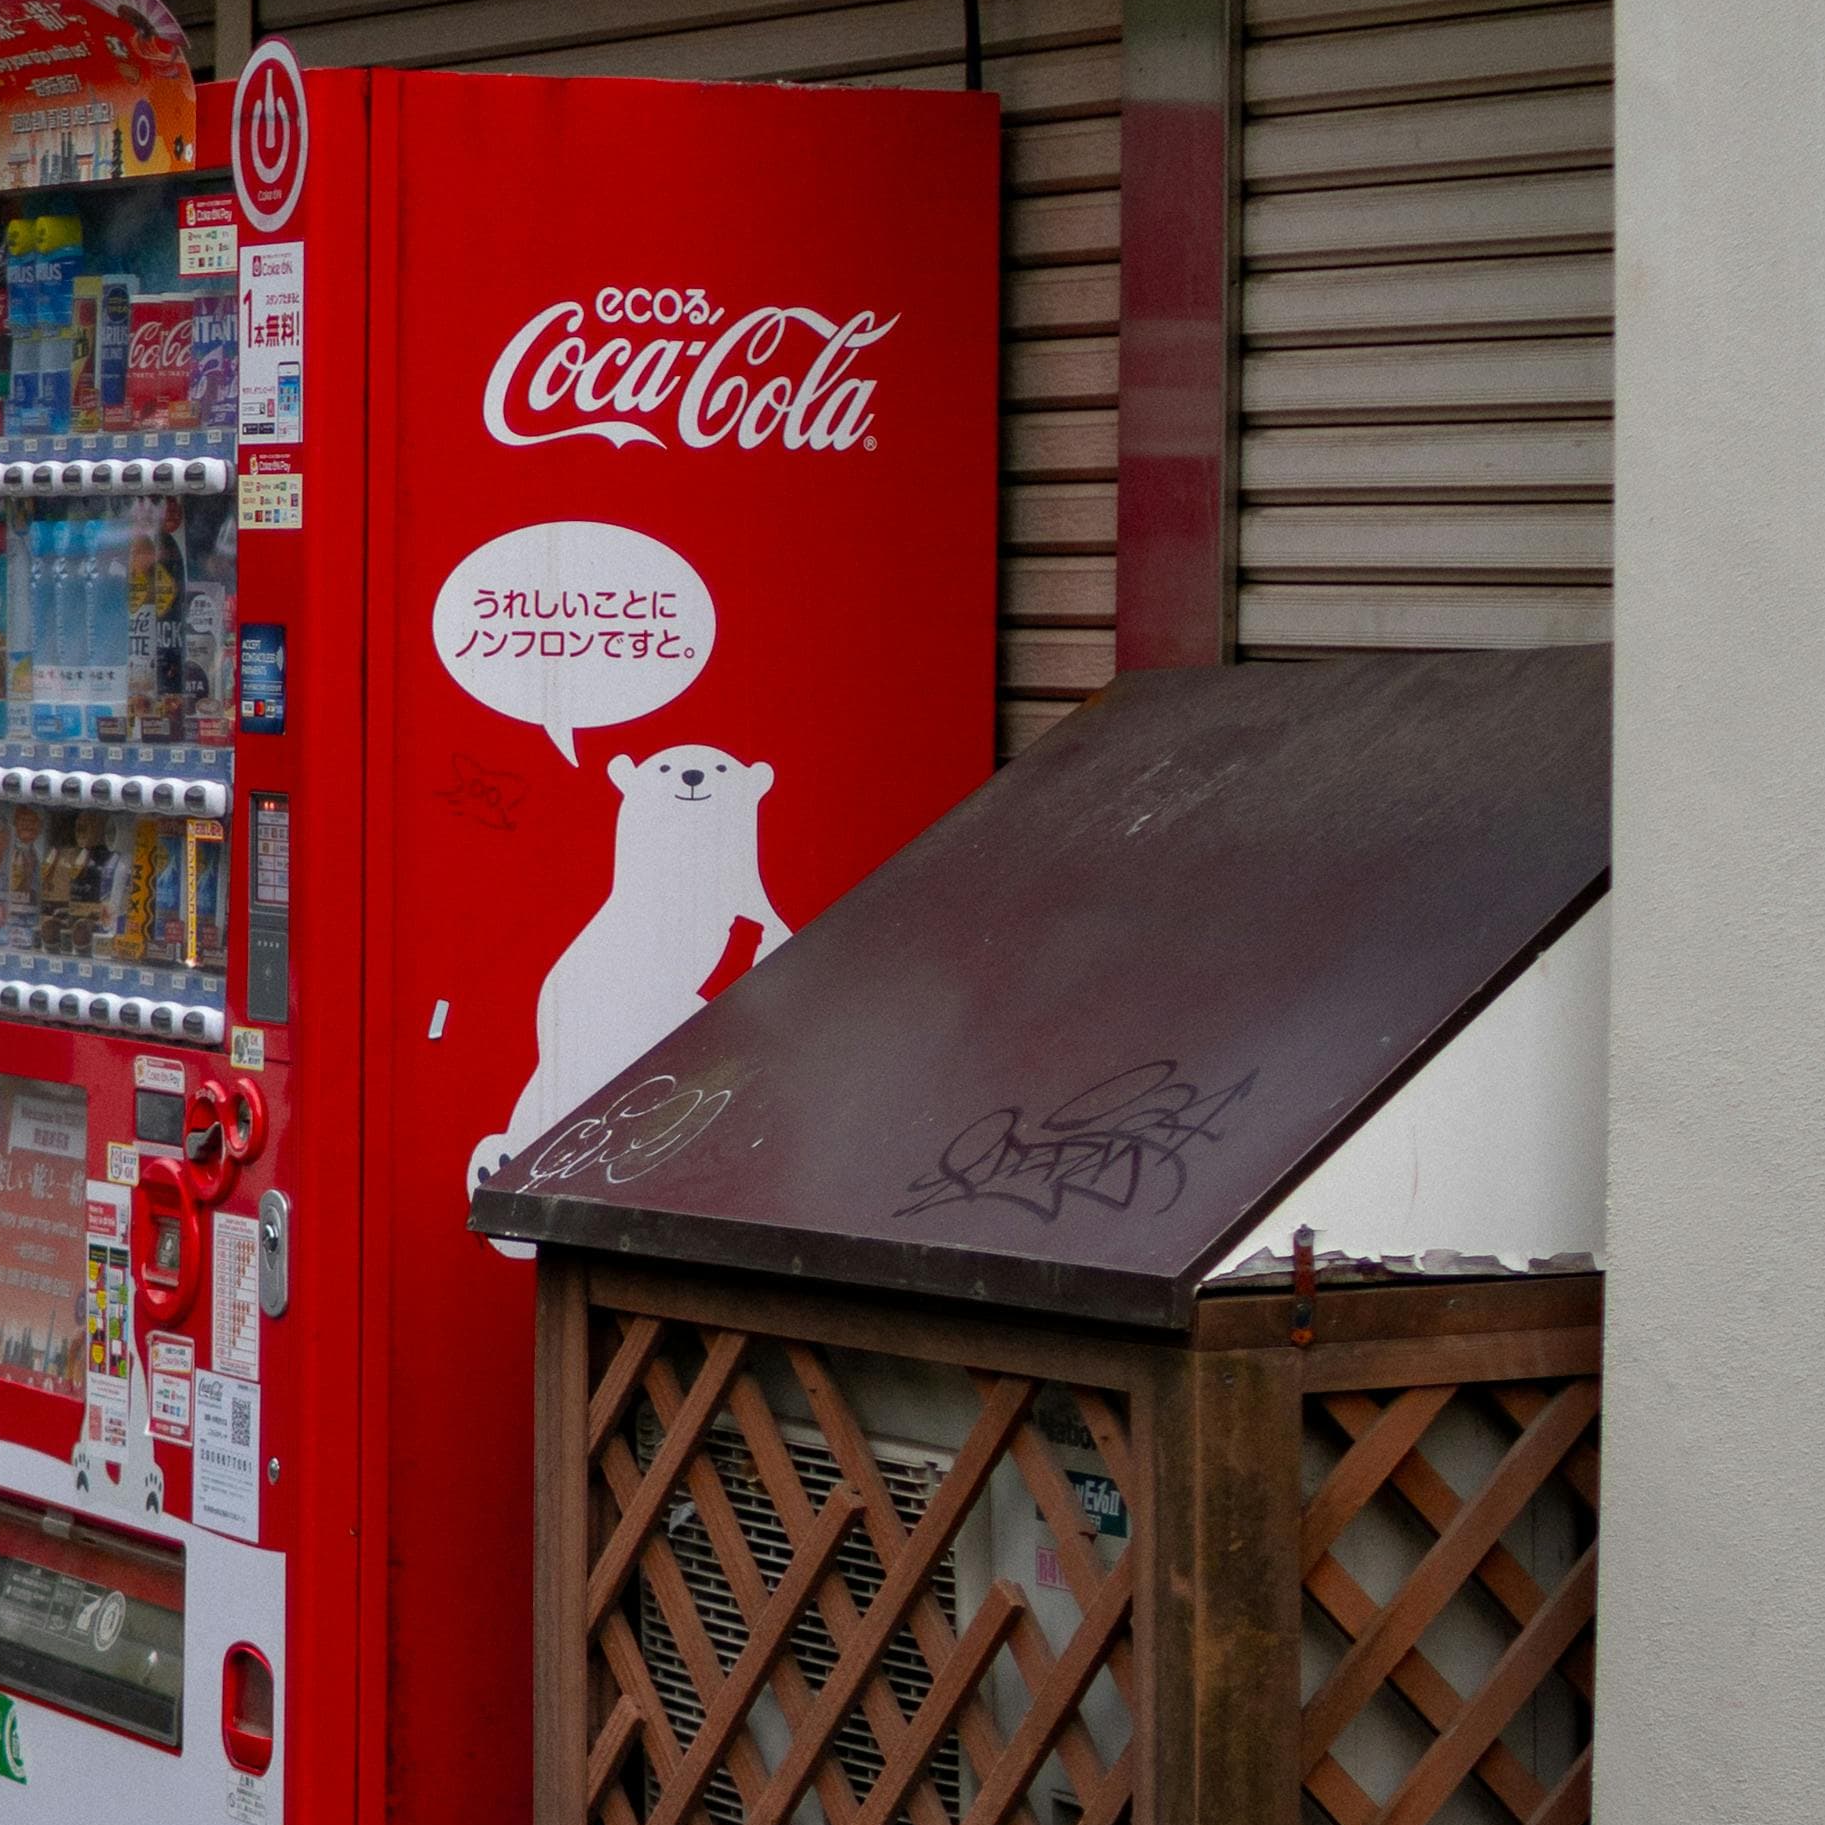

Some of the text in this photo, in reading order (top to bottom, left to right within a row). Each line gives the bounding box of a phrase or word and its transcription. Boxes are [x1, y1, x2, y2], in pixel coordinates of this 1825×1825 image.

[483, 299, 902, 452] Coca-Cola
[473, 589, 677, 619] うれしいことに
[455, 629, 695, 659] ノンフロンですと。
